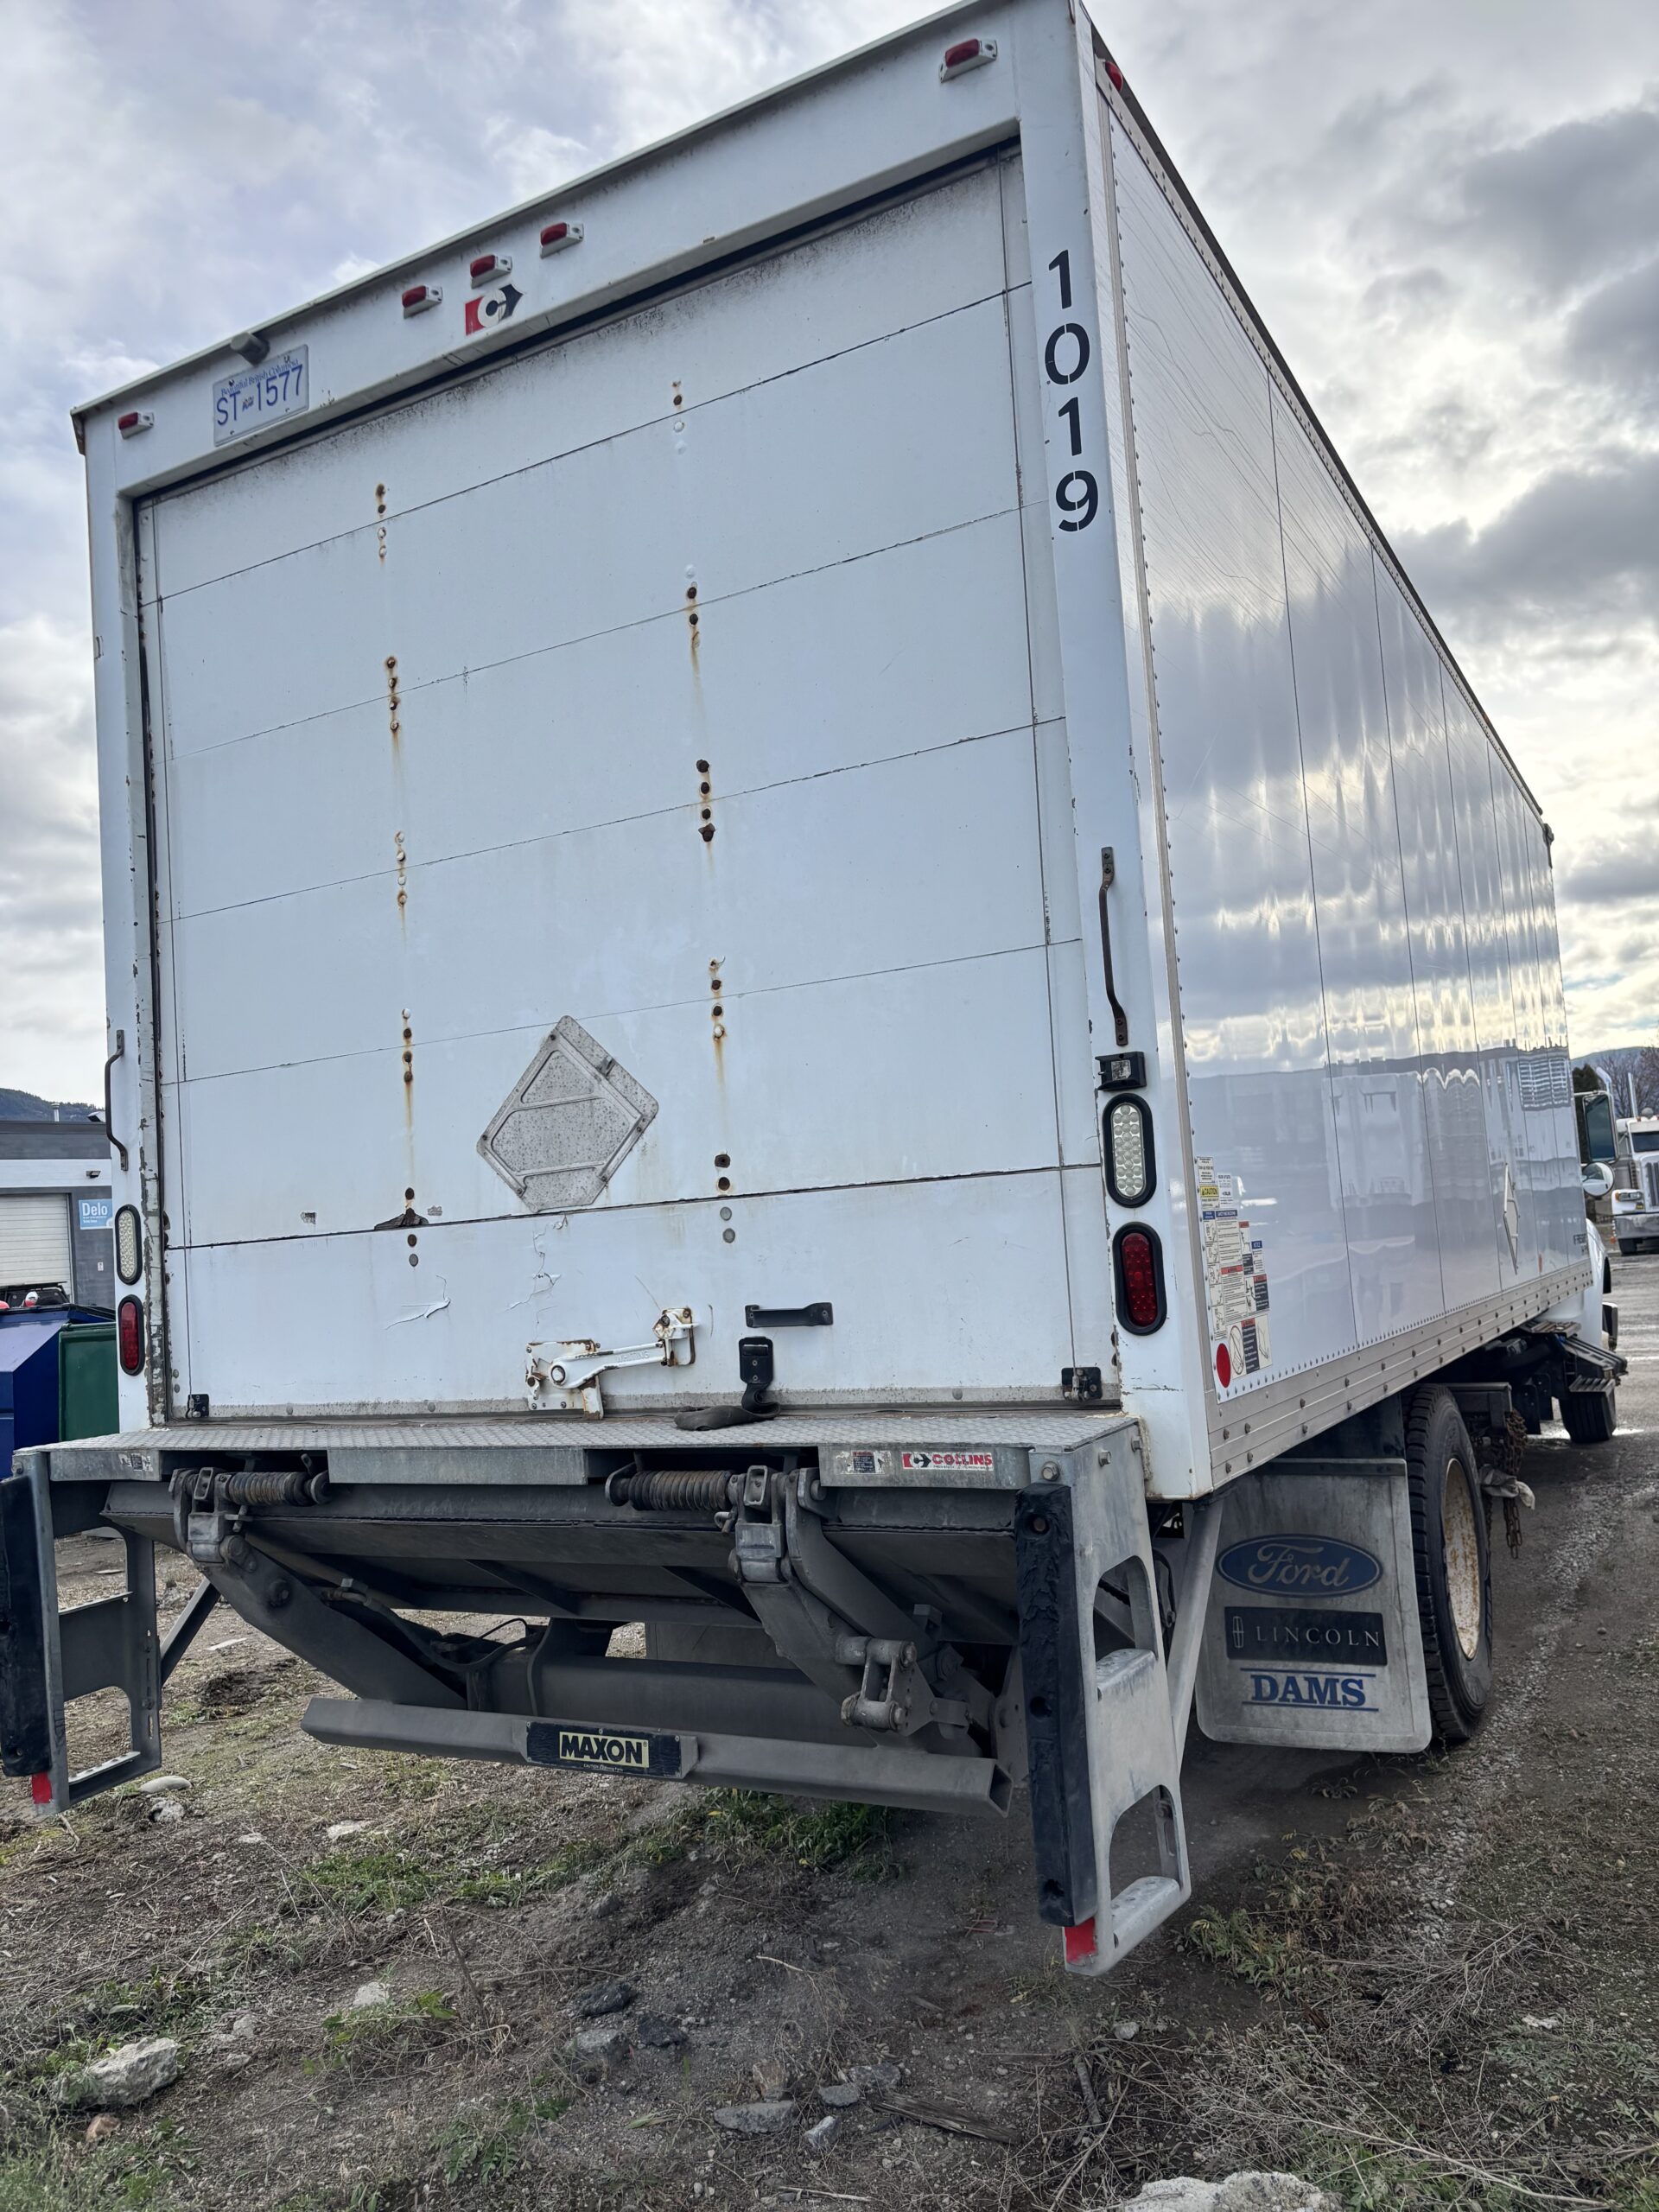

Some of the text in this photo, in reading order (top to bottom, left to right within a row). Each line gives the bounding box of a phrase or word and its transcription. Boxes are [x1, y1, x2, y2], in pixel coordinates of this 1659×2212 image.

[216, 364, 303, 426] ST 1577
[1045, 249, 1098, 531] 1019
[81, 1202, 108, 1217] Delo
[931, 1453, 993, 1466] COLLINS
[1247, 1542, 1351, 1587] Ford
[1255, 1625, 1381, 1648] LINCOLN
[1250, 1674, 1366, 1707] DAMS
[561, 1735, 643, 1764] MAXON
